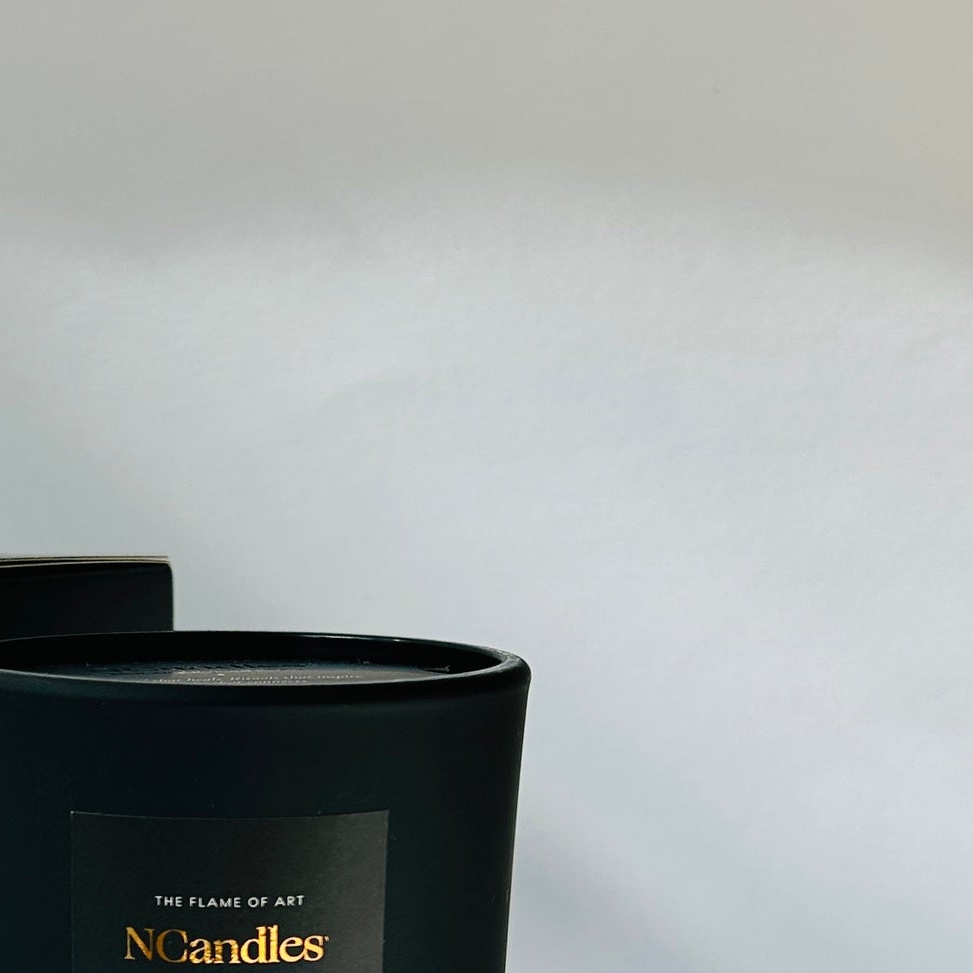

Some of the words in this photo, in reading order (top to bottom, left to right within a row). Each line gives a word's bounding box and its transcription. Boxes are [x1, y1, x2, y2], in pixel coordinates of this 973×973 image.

[154, 895, 183, 907] THE
[189, 896, 241, 908] FLAME
[247, 896, 268, 908] OF
[273, 895, 305, 906] ART
